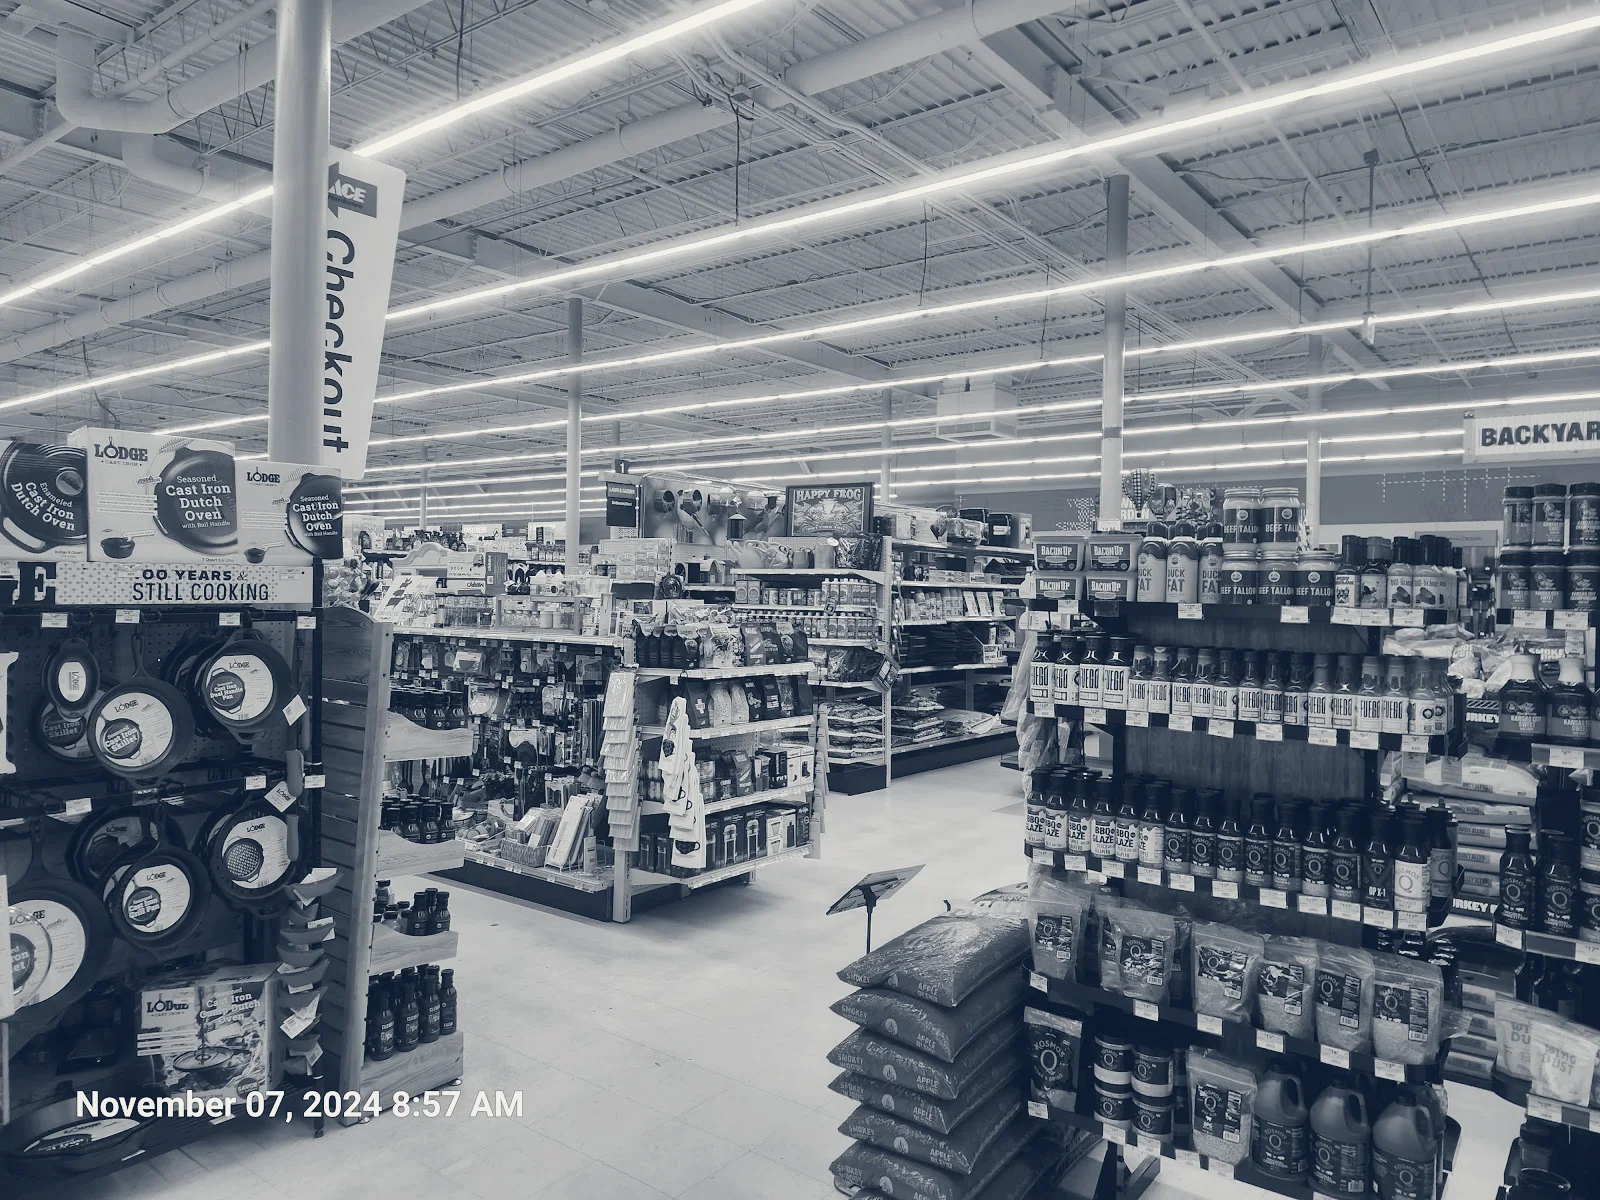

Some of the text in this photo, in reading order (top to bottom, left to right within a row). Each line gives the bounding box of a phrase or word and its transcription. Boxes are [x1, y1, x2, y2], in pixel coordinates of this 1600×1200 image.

[328, 179, 366, 203] ACE
[324, 229, 355, 453] Checkout
[1482, 420, 1600, 447] BACKYAR
[94, 442, 148, 461] LODGE
[620, 462, 625, 474] 1
[177, 474, 217, 483] Seasoned
[247, 472, 280, 483] LODGE
[40, 482, 73, 508] Enameled
[166, 484, 231, 496] Cast Iron
[797, 489, 861, 501] HAPPY FROG
[11, 482, 75, 531] Dutch Oven
[25, 482, 48, 508] Cast
[47, 503, 75, 520] Iron
[179, 496, 222, 509] Dutch
[292, 502, 339, 512] Cast Iron
[185, 510, 222, 521] Oven
[302, 511, 332, 521] Dutch
[306, 523, 332, 531] Oven
[1266, 524, 1282, 532] BEEF
[136, 570, 247, 581] 00 YEARS &
[1168, 568, 1185, 577] DUCK
[133, 583, 269, 601] STILL COOKING
[1168, 579, 1185, 592] FAT
[1242, 691, 1260, 708] FUEGO
[48, 727, 78, 738] Skillet
[1095, 827, 1110, 835] BBQ
[1093, 834, 1114, 843] GLAZE
[1221, 847, 1233, 862] Q
[1308, 859, 1321, 876] Q
[1336, 865, 1349, 880] Q
[1399, 875, 1413, 893] Q
[1506, 884, 1521, 902] Q
[1453, 899, 1488, 912] URKEY
[1551, 891, 1567, 909] Q
[12, 951, 29, 961] ron
[231, 993, 252, 1003] Iron
[231, 1000, 261, 1013] Dutch
[841, 1005, 868, 1019] SMOKEY
[1511, 1022, 1530, 1034] WI
[917, 1033, 936, 1049] APPLE
[1511, 1031, 1531, 1044] DU
[838, 1054, 863, 1065] SMOKEY
[1041, 1049, 1057, 1076] Q
[841, 1082, 864, 1093] SMOKEY
[917, 1076, 939, 1088] APPLE
[1204, 1096, 1216, 1112] Q
[913, 1106, 933, 1121] APPLE
[848, 1125, 875, 1136] SMOKEY
[1269, 1134, 1281, 1149] Q
[930, 1148, 952, 1161] APPLE
[1318, 1147, 1330, 1163] Q
[837, 1165, 862, 1176] SMOKEY
[1400, 1170, 1413, 1186] Q
